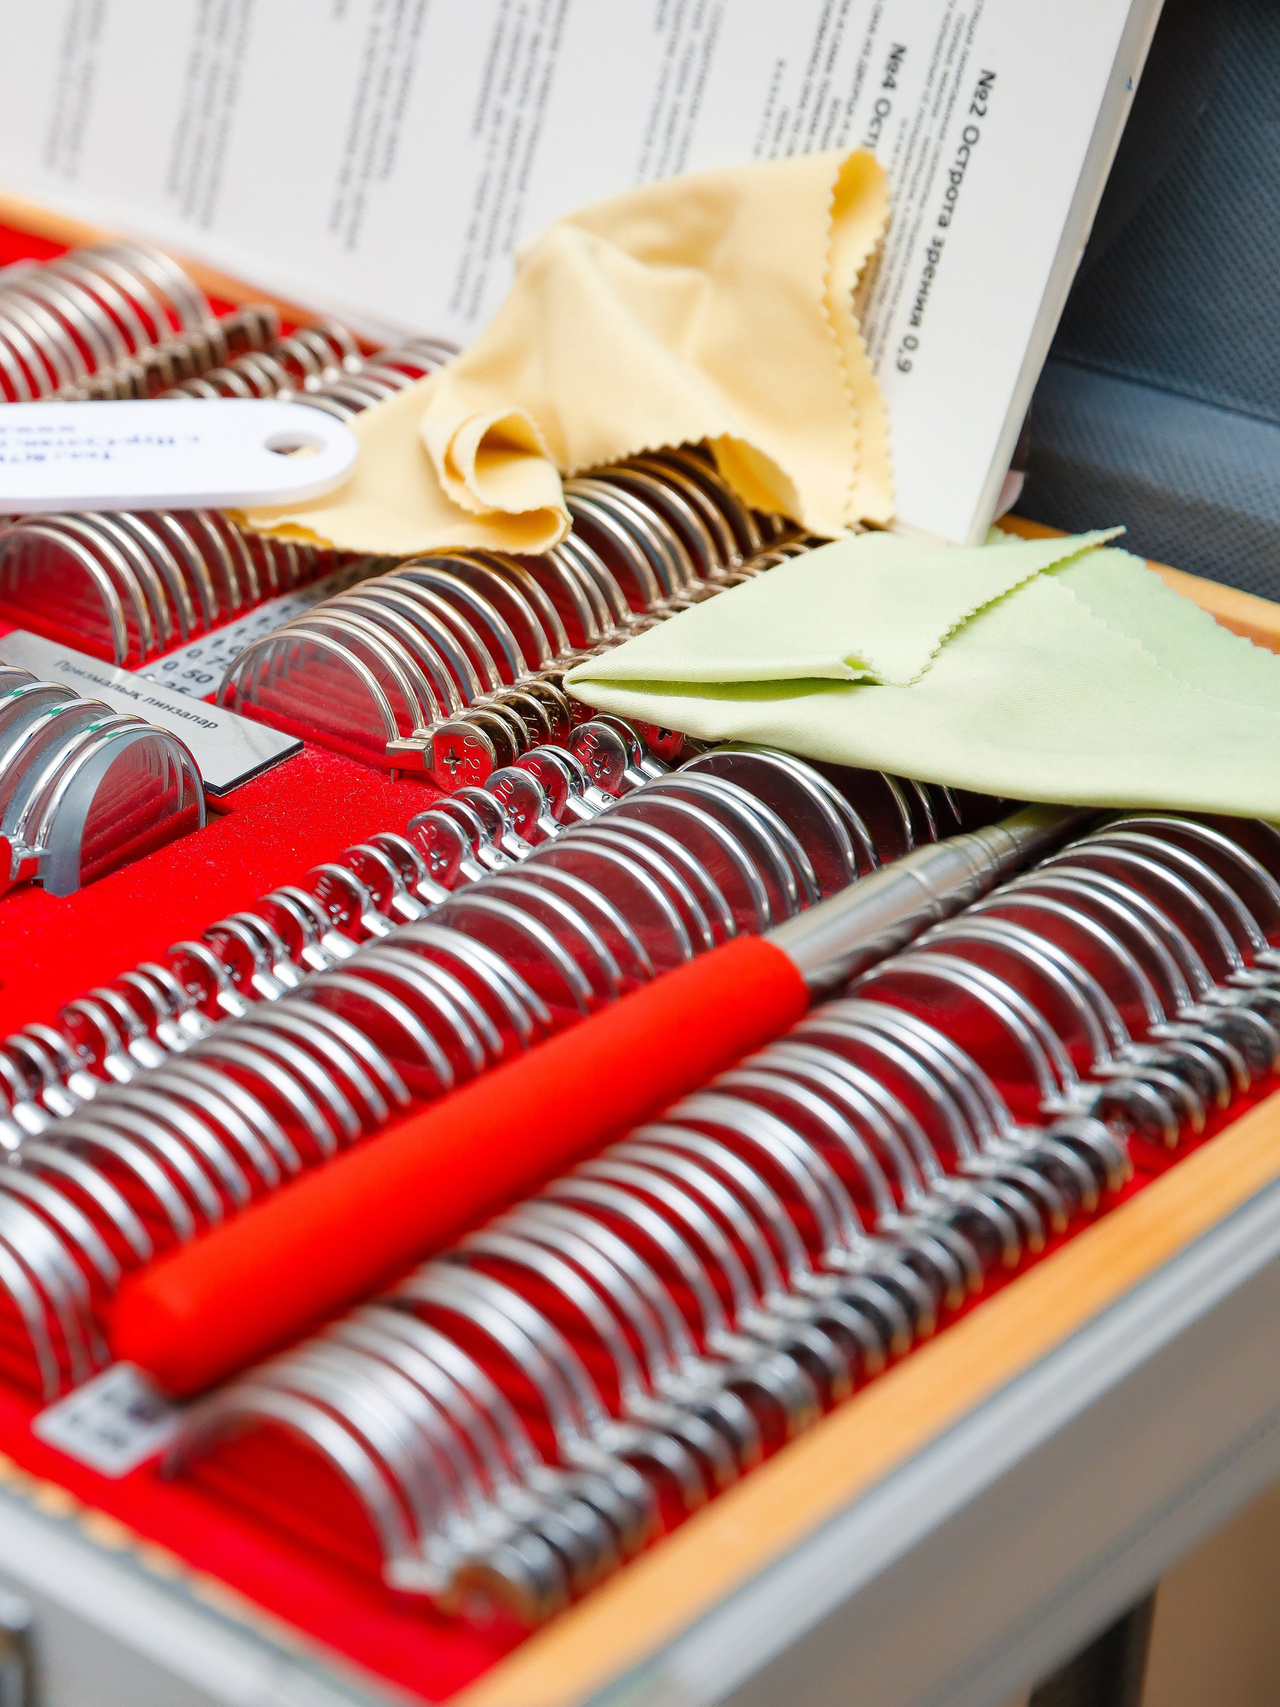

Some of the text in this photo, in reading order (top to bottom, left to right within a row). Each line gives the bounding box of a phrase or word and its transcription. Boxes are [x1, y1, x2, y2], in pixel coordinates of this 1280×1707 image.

[881, 42, 906, 90] №4
[896, 68, 996, 373] №2 Острота зрения 0,9
[54, 659, 219, 730] Призмалық линзалар
